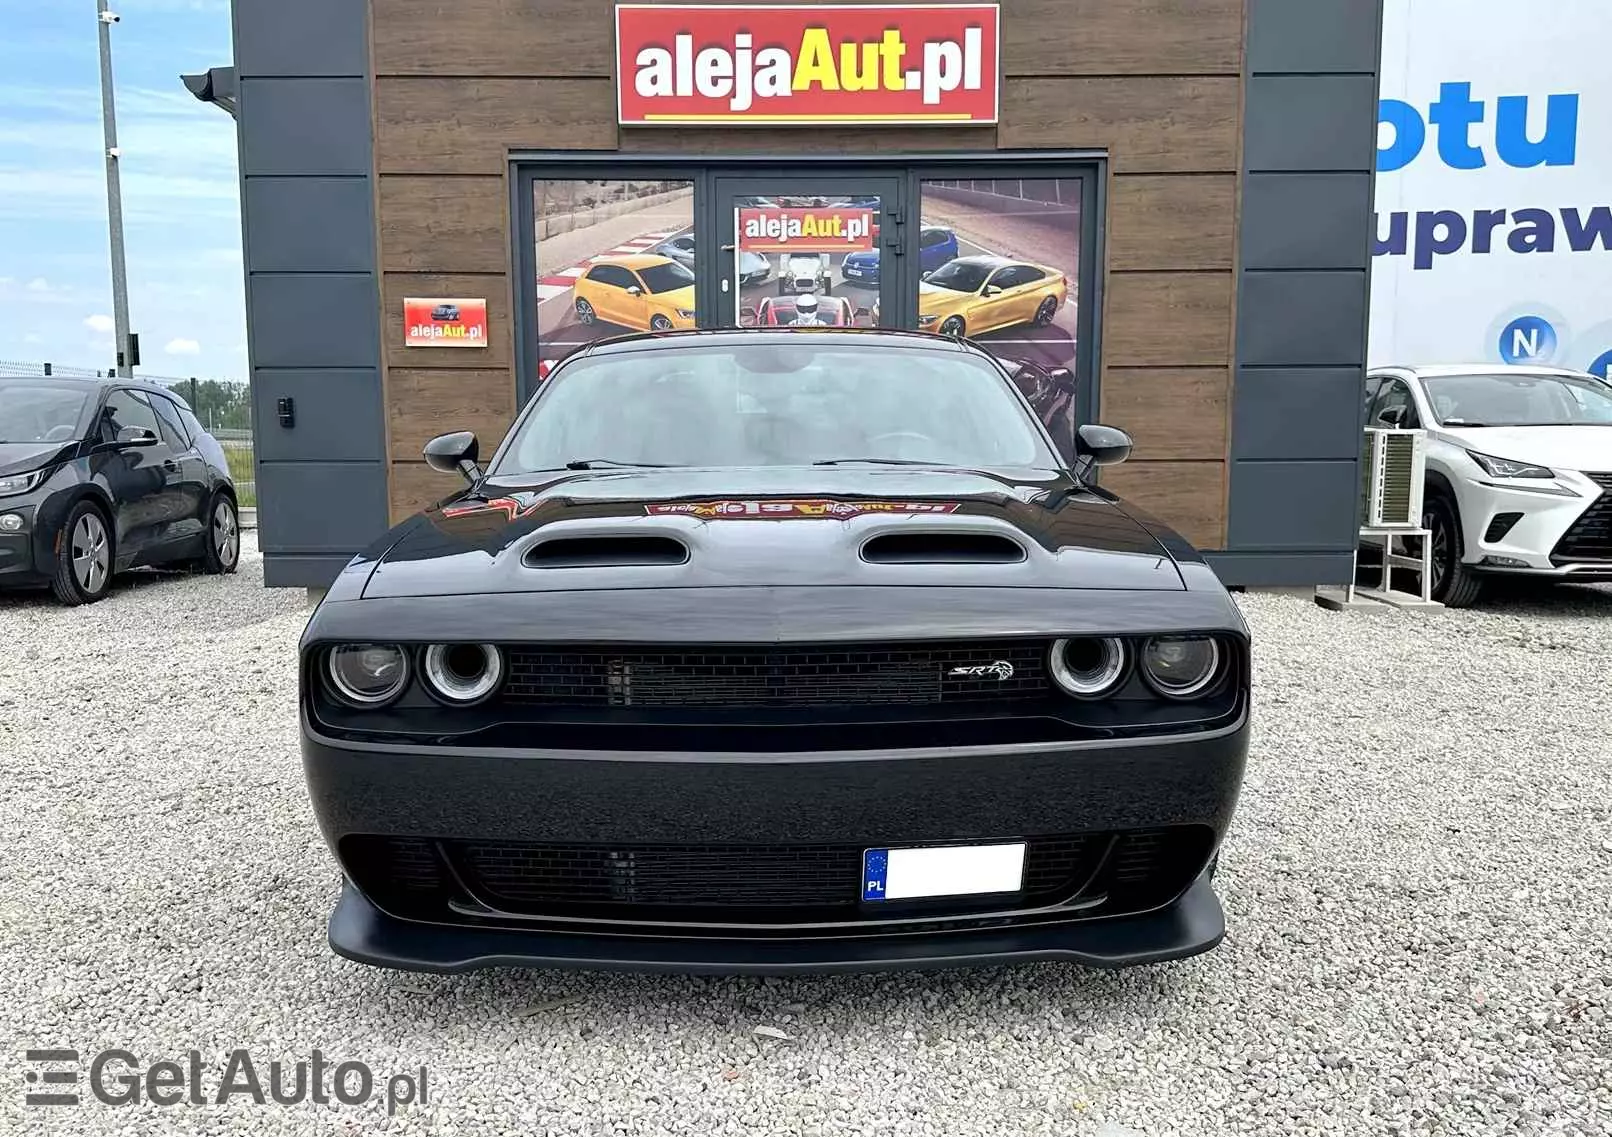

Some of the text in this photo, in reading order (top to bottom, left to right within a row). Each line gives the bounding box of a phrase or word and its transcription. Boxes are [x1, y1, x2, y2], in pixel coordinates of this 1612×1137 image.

[634, 27, 983, 111] alejaAut.pl
[745, 214, 869, 242] alejaAut.pl
[410, 323, 483, 340] alejaAut.pl
[1512, 328, 1538, 357] N
[947, 665, 1000, 676] SRT
[867, 881, 884, 892] PL
